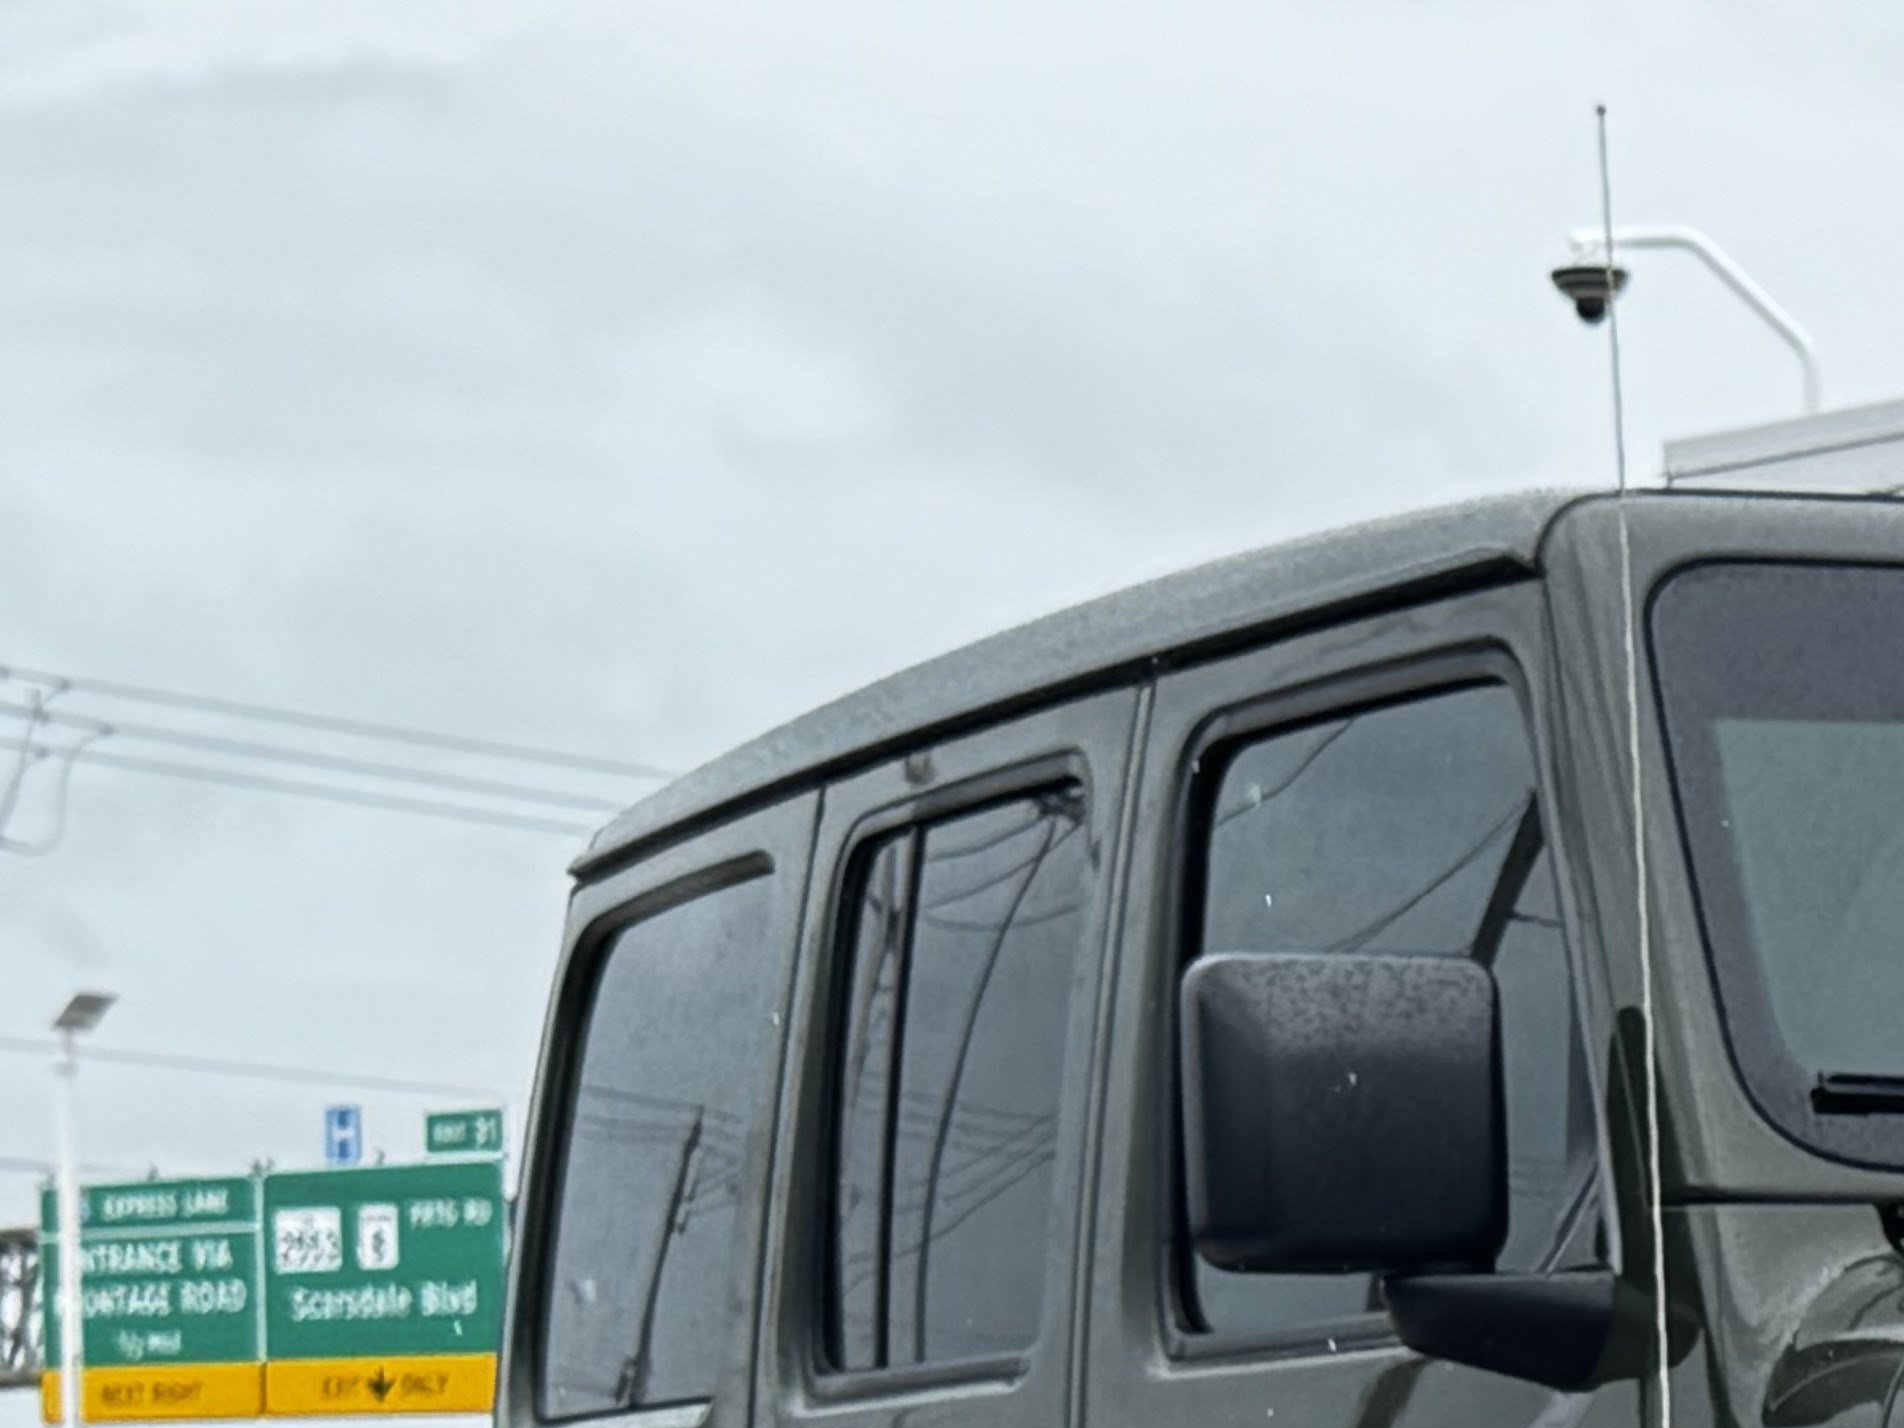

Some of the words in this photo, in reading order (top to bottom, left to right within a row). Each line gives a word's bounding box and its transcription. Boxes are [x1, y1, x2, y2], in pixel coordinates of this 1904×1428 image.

[103, 1192, 178, 1221] EXPRESS
[184, 1187, 229, 1216] LANE
[79, 1243, 183, 1274] NTRANCE
[192, 1239, 233, 1270] VIA
[54, 1282, 172, 1318] ONTAGE
[181, 1279, 247, 1314] ROAD
[421, 1278, 478, 1316] Blvd
